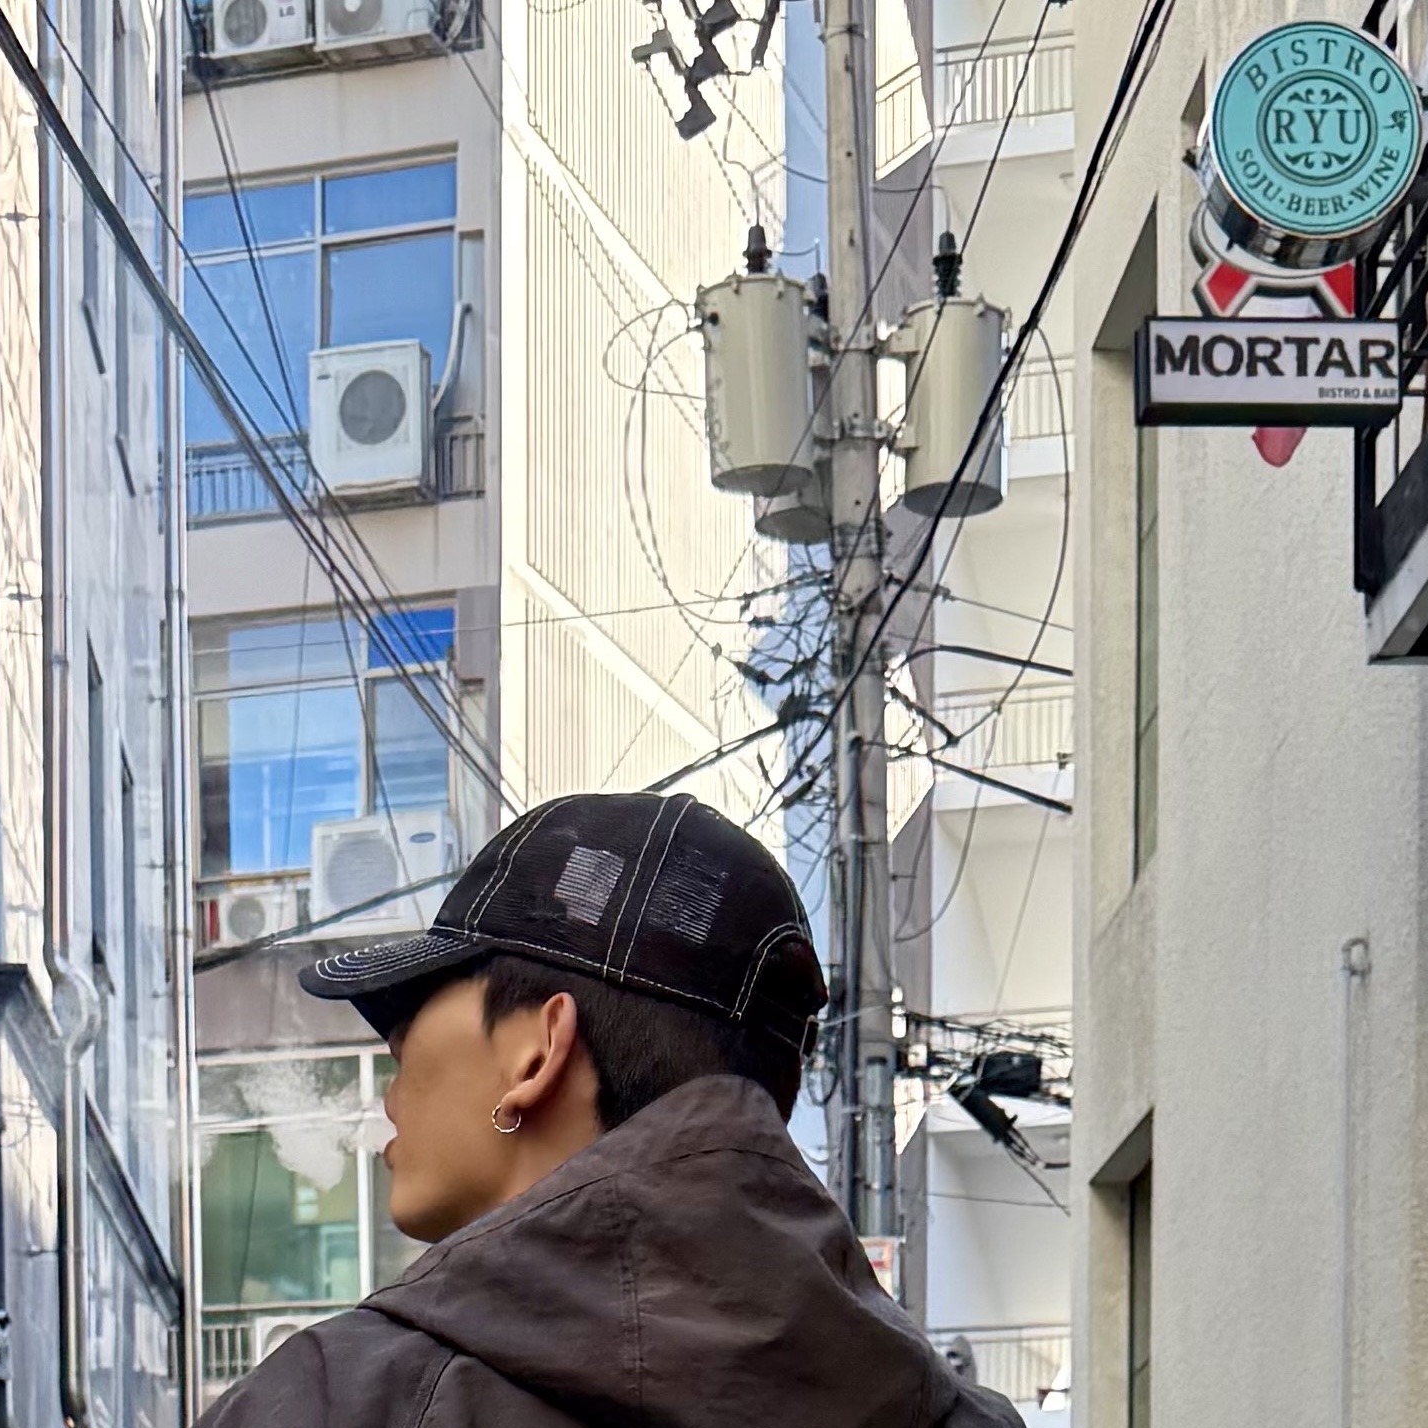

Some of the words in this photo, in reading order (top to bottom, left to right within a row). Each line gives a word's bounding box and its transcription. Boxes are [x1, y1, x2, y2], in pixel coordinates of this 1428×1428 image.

[1244, 38, 1391, 94] BISTRO
[1273, 108, 1362, 145] RYU
[1155, 335, 1398, 378] MORTAR
[1318, 387, 1360, 399] BISTRO
